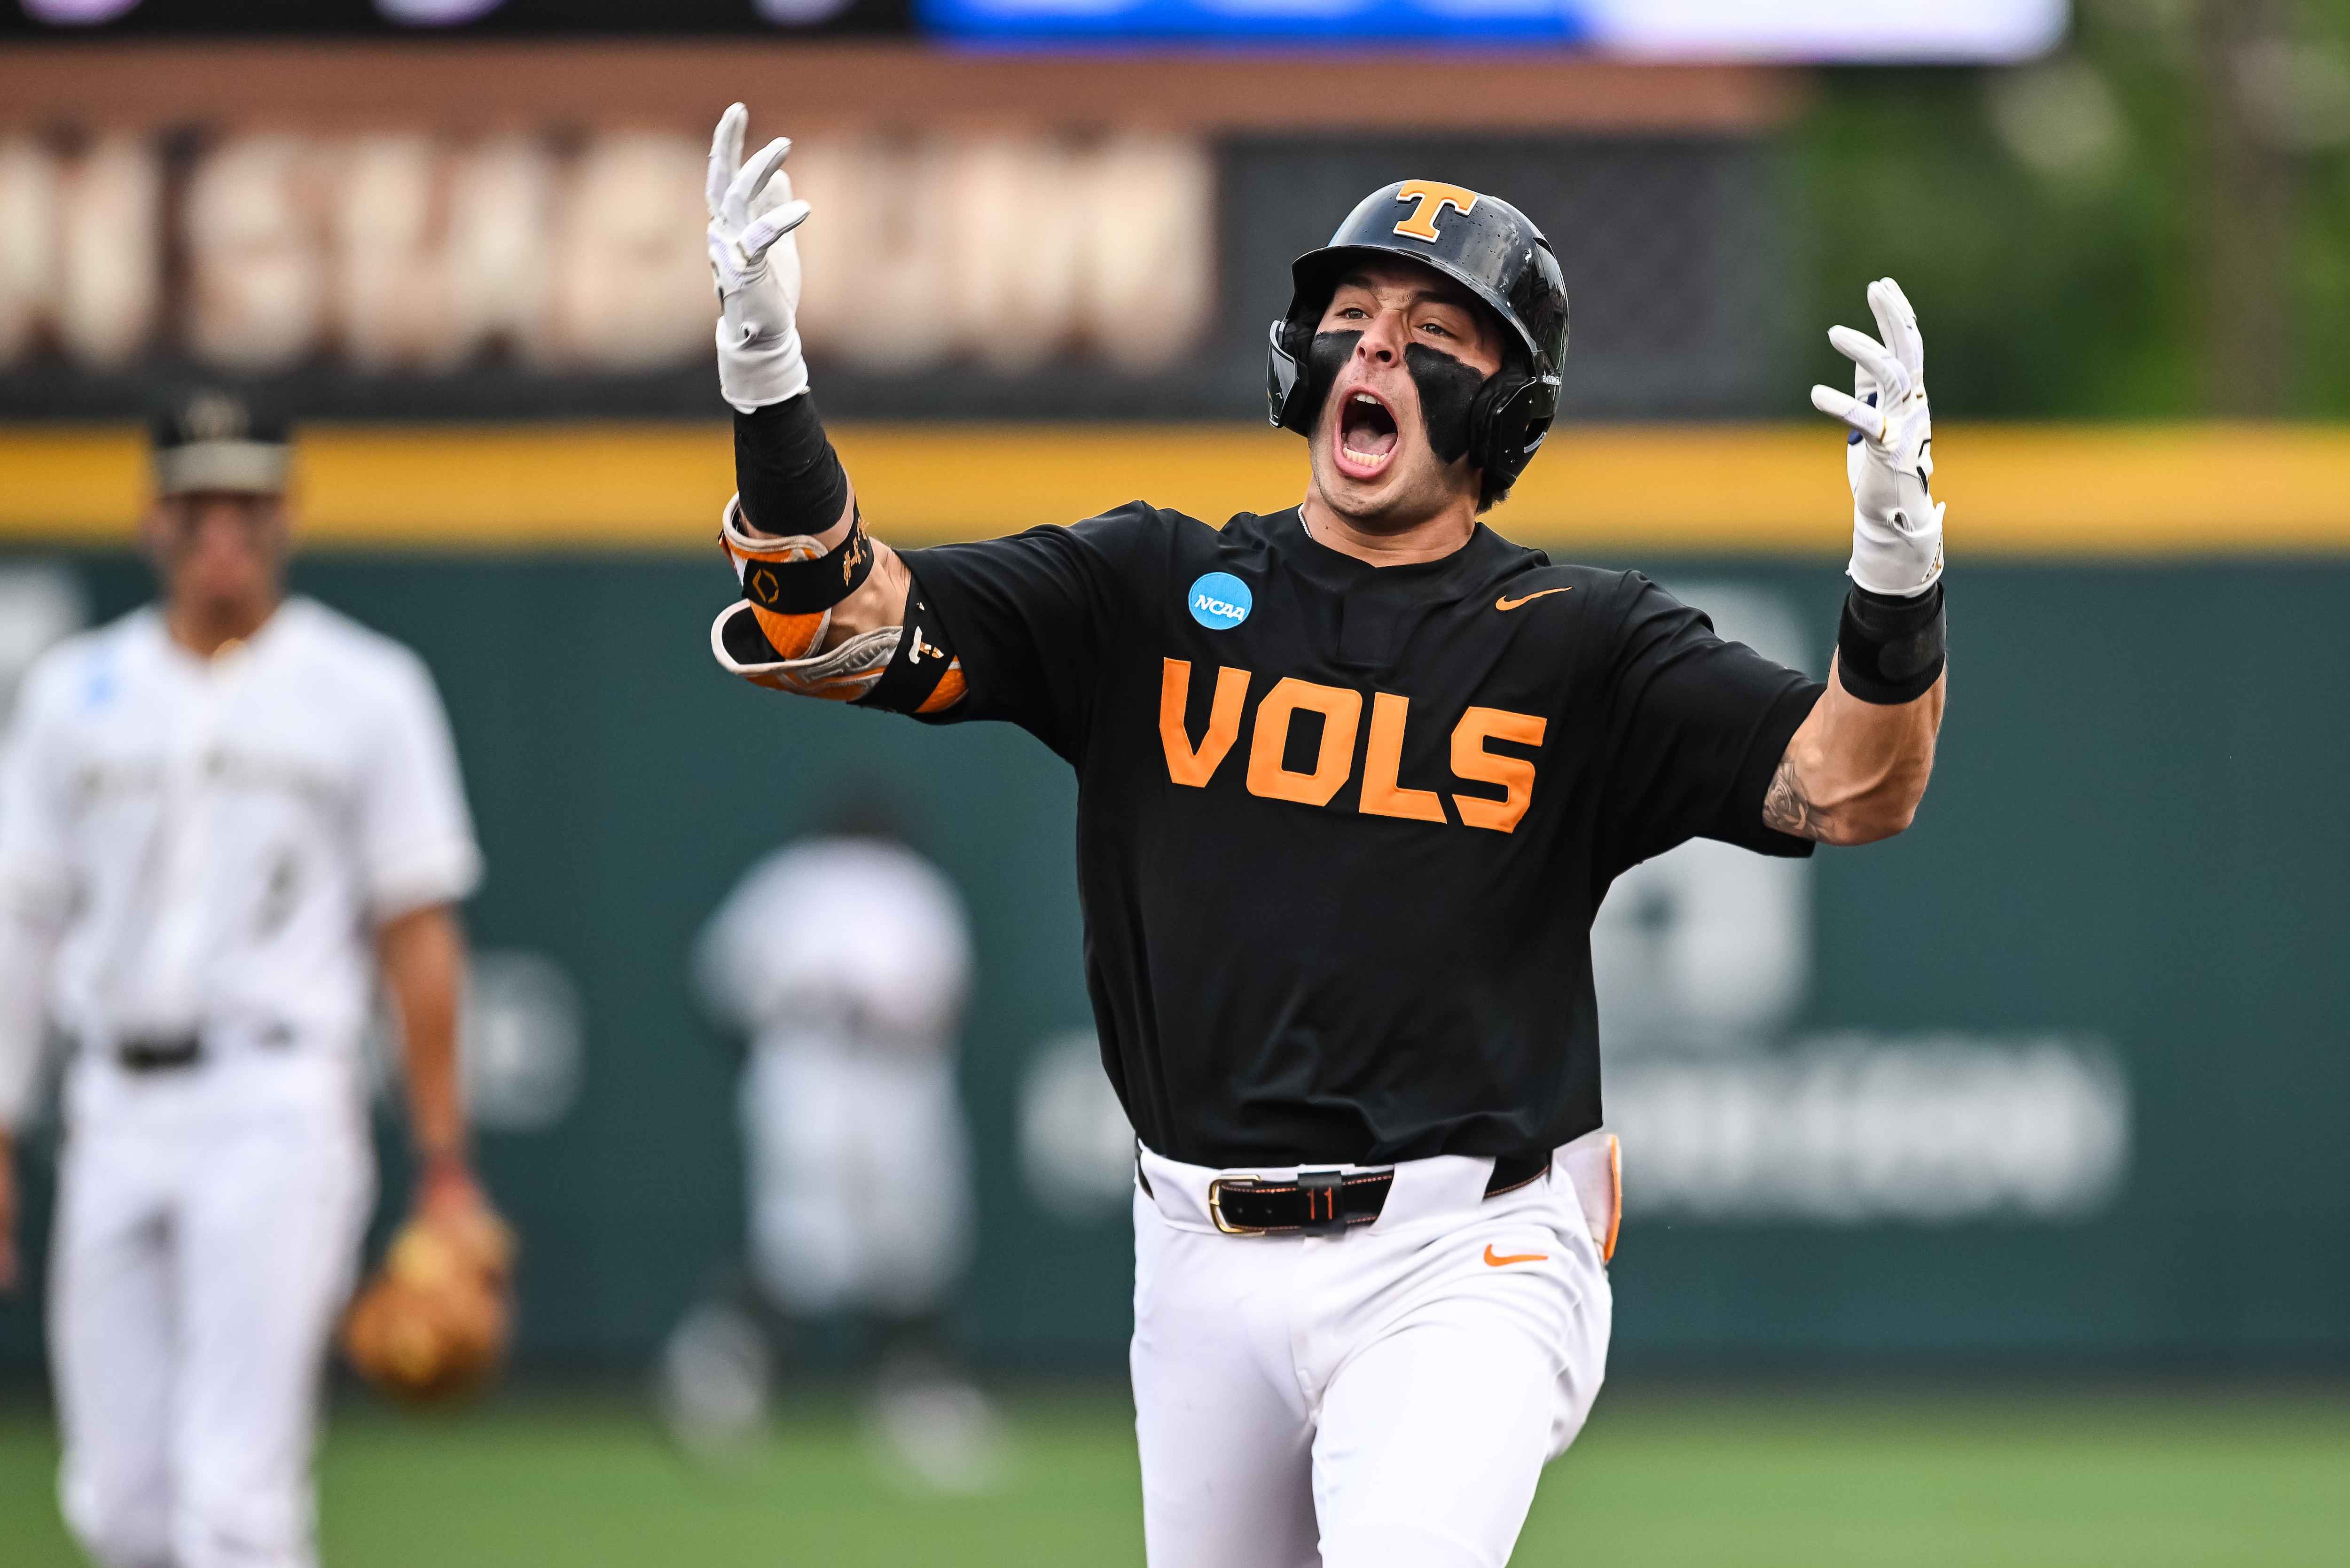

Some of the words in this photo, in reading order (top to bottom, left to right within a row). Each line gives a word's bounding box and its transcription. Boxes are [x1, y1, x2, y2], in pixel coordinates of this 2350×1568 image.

[1393, 179, 1479, 243] T
[1194, 594, 1246, 621] NCAA
[1159, 656, 1548, 834] VOLS
[1307, 1186, 1332, 1220] 11
